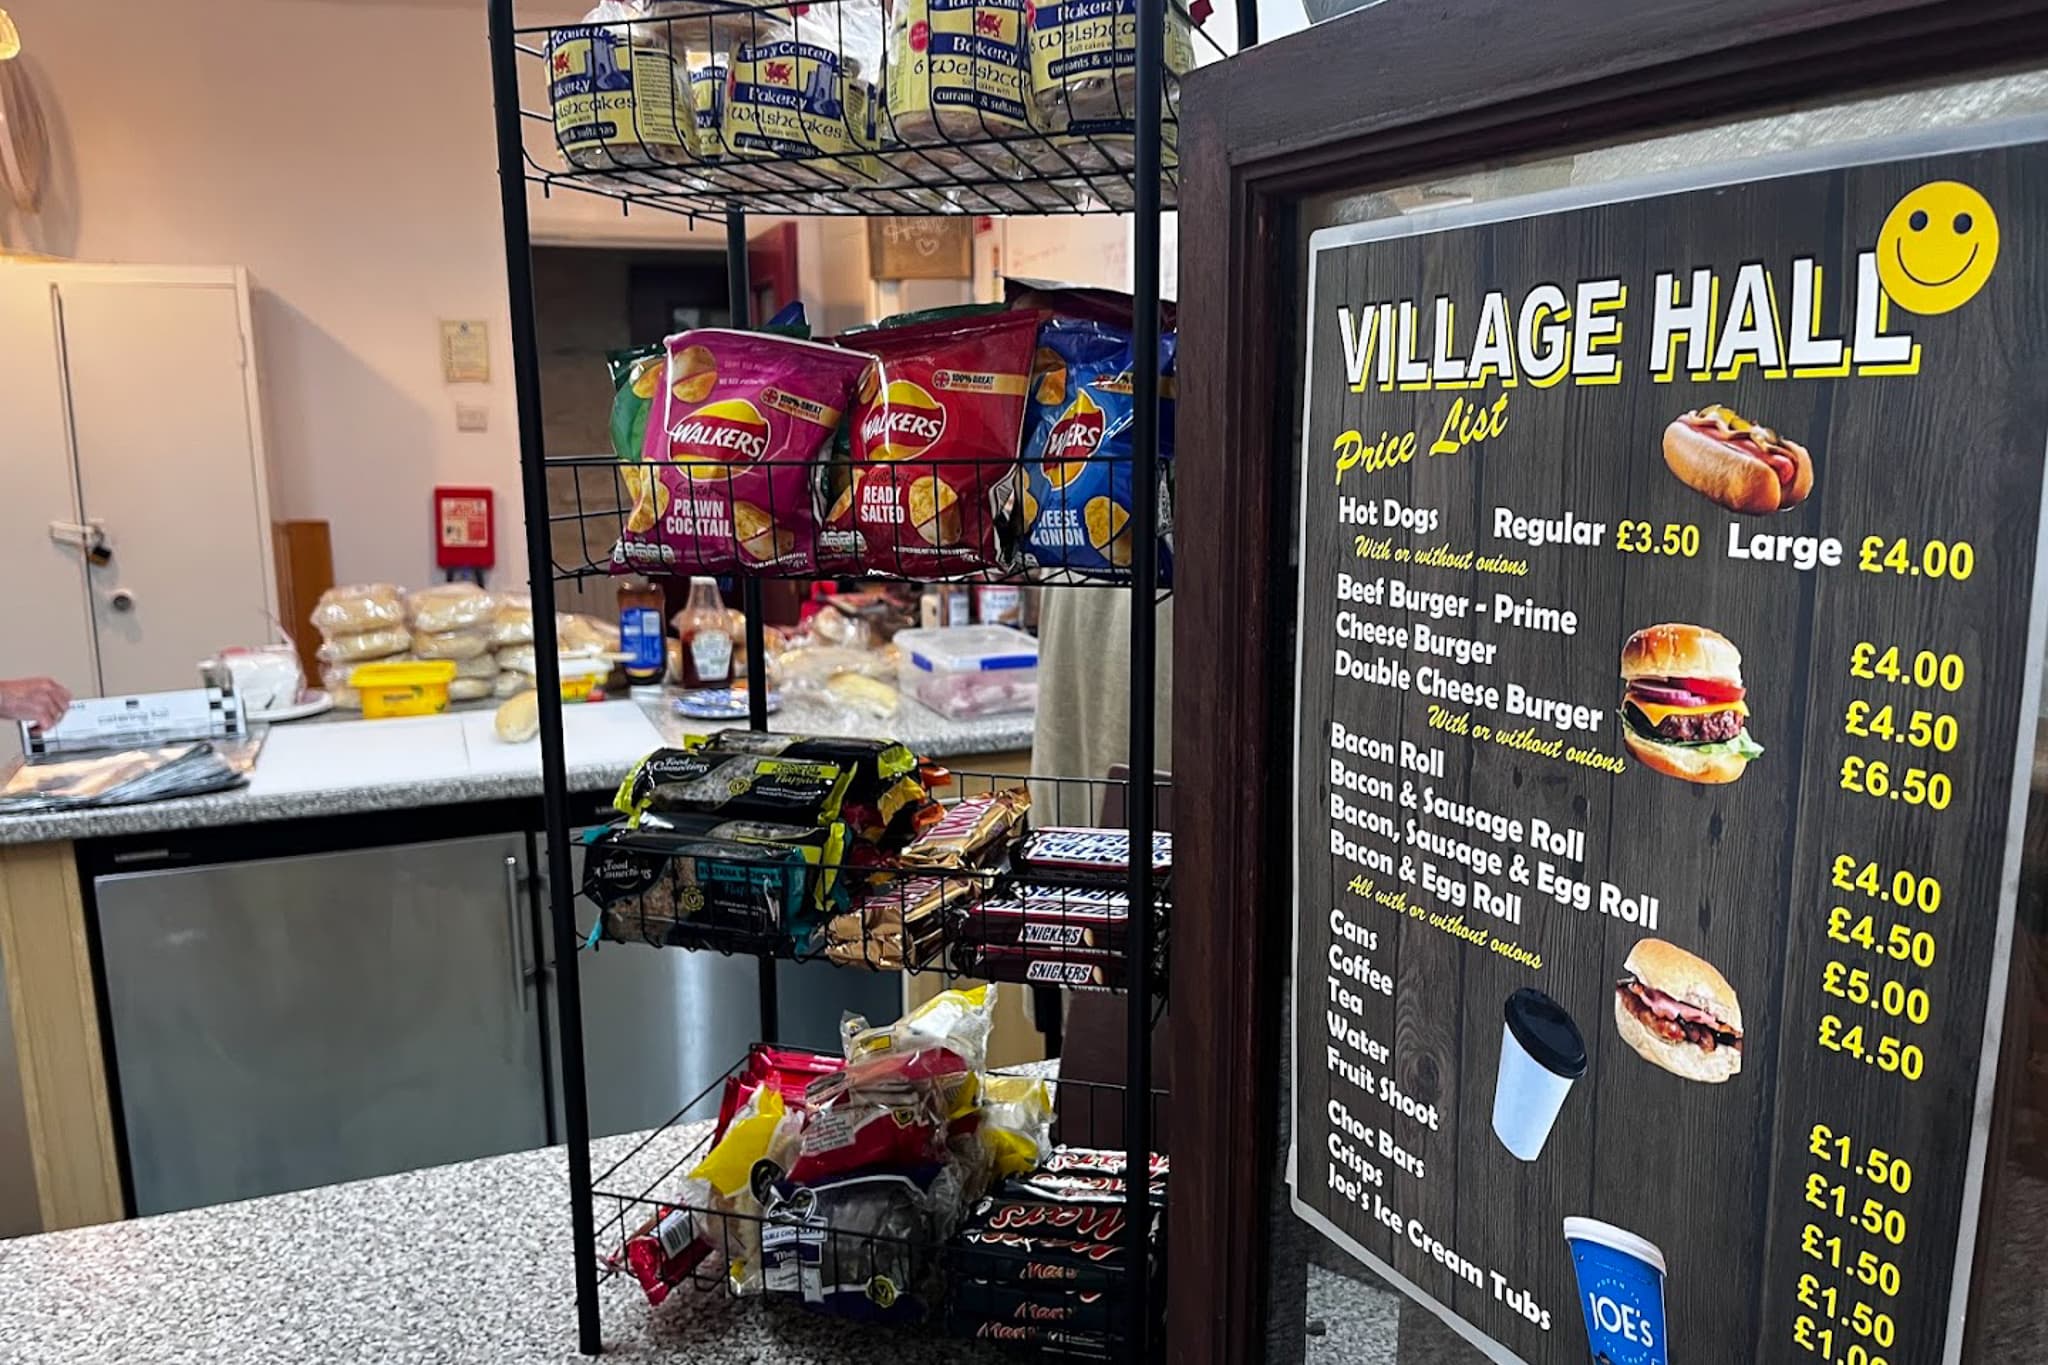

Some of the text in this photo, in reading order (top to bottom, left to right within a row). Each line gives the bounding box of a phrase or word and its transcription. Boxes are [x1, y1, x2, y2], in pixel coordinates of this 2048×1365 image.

[914, 59, 1032, 89] 6 Welshcak
[936, 91, 977, 102] currant
[1336, 250, 1921, 393] VILLAGE HALL
[673, 421, 766, 458] WALKERS
[863, 411, 942, 442] WALKERS
[1333, 392, 1509, 485] Price List
[861, 504, 905, 524] SALTED
[863, 485, 902, 504] READY
[1038, 509, 1079, 528] HEESE
[1338, 495, 1976, 581] Hot Dogs Regular £3.50 Large £4.00
[1354, 534, 1529, 577] With or without onions
[1336, 572, 1385, 605] Beef
[1389, 579, 1469, 620] Burger
[1494, 593, 1578, 636] Prime
[1849, 641, 1966, 693] £4.00
[1335, 611, 1960, 753] Cheese Burger £4.50
[1334, 649, 1954, 811] Double Cheese Burger £6.50
[1426, 703, 1627, 776] With or without onions
[1329, 721, 1943, 915] Bacon Roll £4.00
[1329, 757, 1936, 968] Bacon & Sausage Roll £4.50
[1023, 925, 1081, 943] SNICKERS
[1329, 792, 1931, 1025] Bacon, Sausage & Egg Roll £5.00
[1329, 828, 1925, 1081] Bacon & Egg Roll £4.50
[1346, 874, 1543, 971] All with or without onions
[1029, 962, 1091, 981] SNICKERS
[1328, 943, 1908, 1245] Coffee £1.50
[1329, 908, 1913, 1195] Cans £1.50
[1327, 975, 1901, 1297] Tea £1.50
[1327, 1010, 1896, 1349] Water £1.50
[1328, 1099, 1426, 1179] Choc Bars
[1328, 1133, 1385, 1188] Crisps
[1327, 1045, 1889, 1365] Fruit Shoot £1.0
[1328, 1163, 1370, 1212] Joe's
[1374, 1200, 1404, 1235] Ice
[1407, 1220, 1484, 1290] Cream
[1489, 1268, 1553, 1332] Tubs
